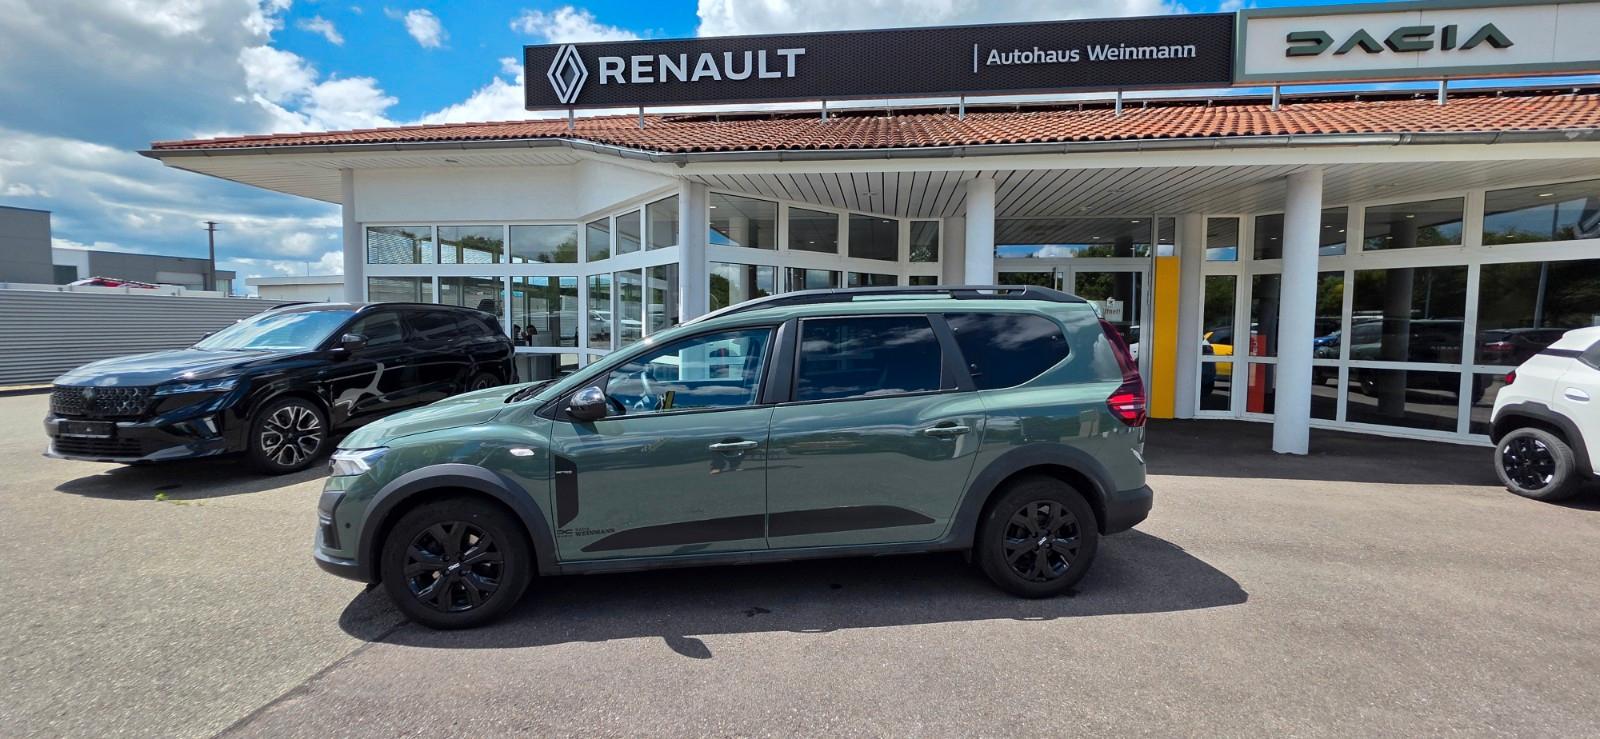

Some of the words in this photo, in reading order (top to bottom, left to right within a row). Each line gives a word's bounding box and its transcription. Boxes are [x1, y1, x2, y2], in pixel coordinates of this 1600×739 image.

[986, 47, 1080, 65] Autohaus
[1087, 43, 1196, 61] Weinmann
[1286, 22, 1514, 57] DACIA
[598, 48, 806, 84] RENAULT
